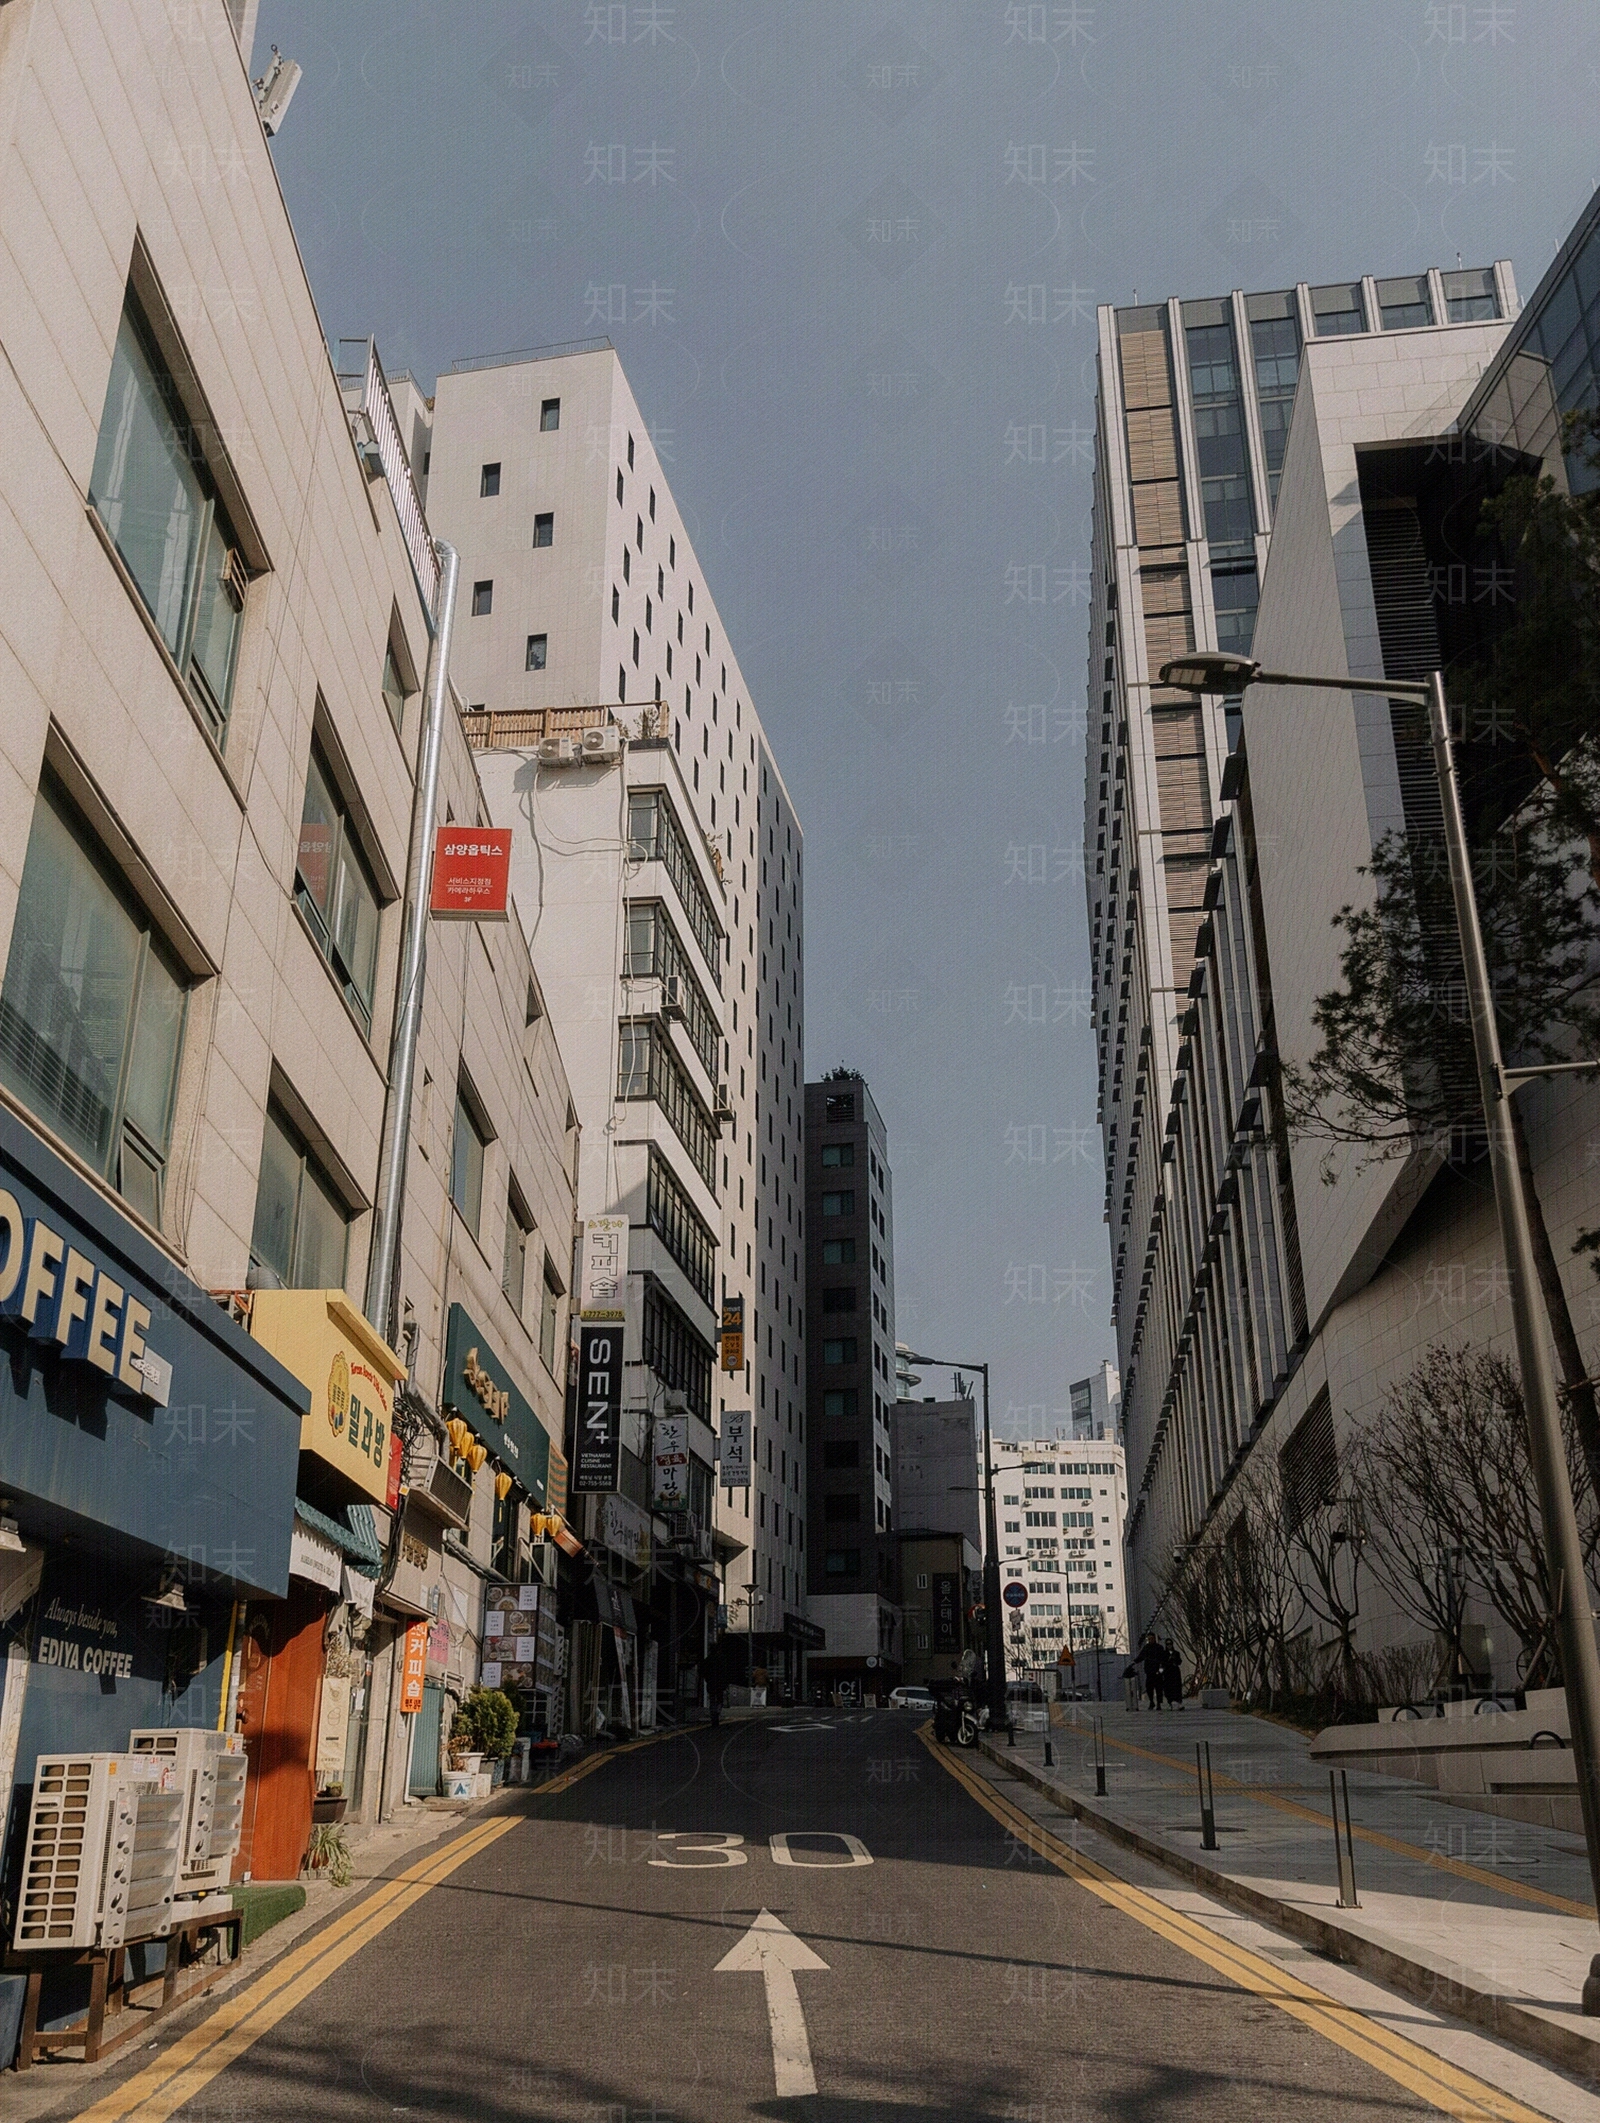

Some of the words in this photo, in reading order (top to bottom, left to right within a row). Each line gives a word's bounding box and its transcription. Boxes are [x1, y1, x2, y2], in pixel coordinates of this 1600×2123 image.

[444, 844, 503, 856] 삼양옵틱스
[589, 1233, 619, 1299] 커피숍
[723, 1312, 742, 1326] 24
[348, 1393, 385, 1468] 밀과방
[659, 1422, 682, 1452] 한우
[727, 1426, 744, 1463] 부석
[662, 1467, 678, 1497] 마당
[44, 1596, 77, 1631] Always
[77, 1603, 102, 1631] beside
[940, 1580, 953, 1636] 올스테이
[38, 1635, 80, 1670] EDIYA
[83, 1646, 133, 1679] COFFEE
[406, 1638, 424, 1698] 커피숍
[647, 1831, 875, 1868] 30
